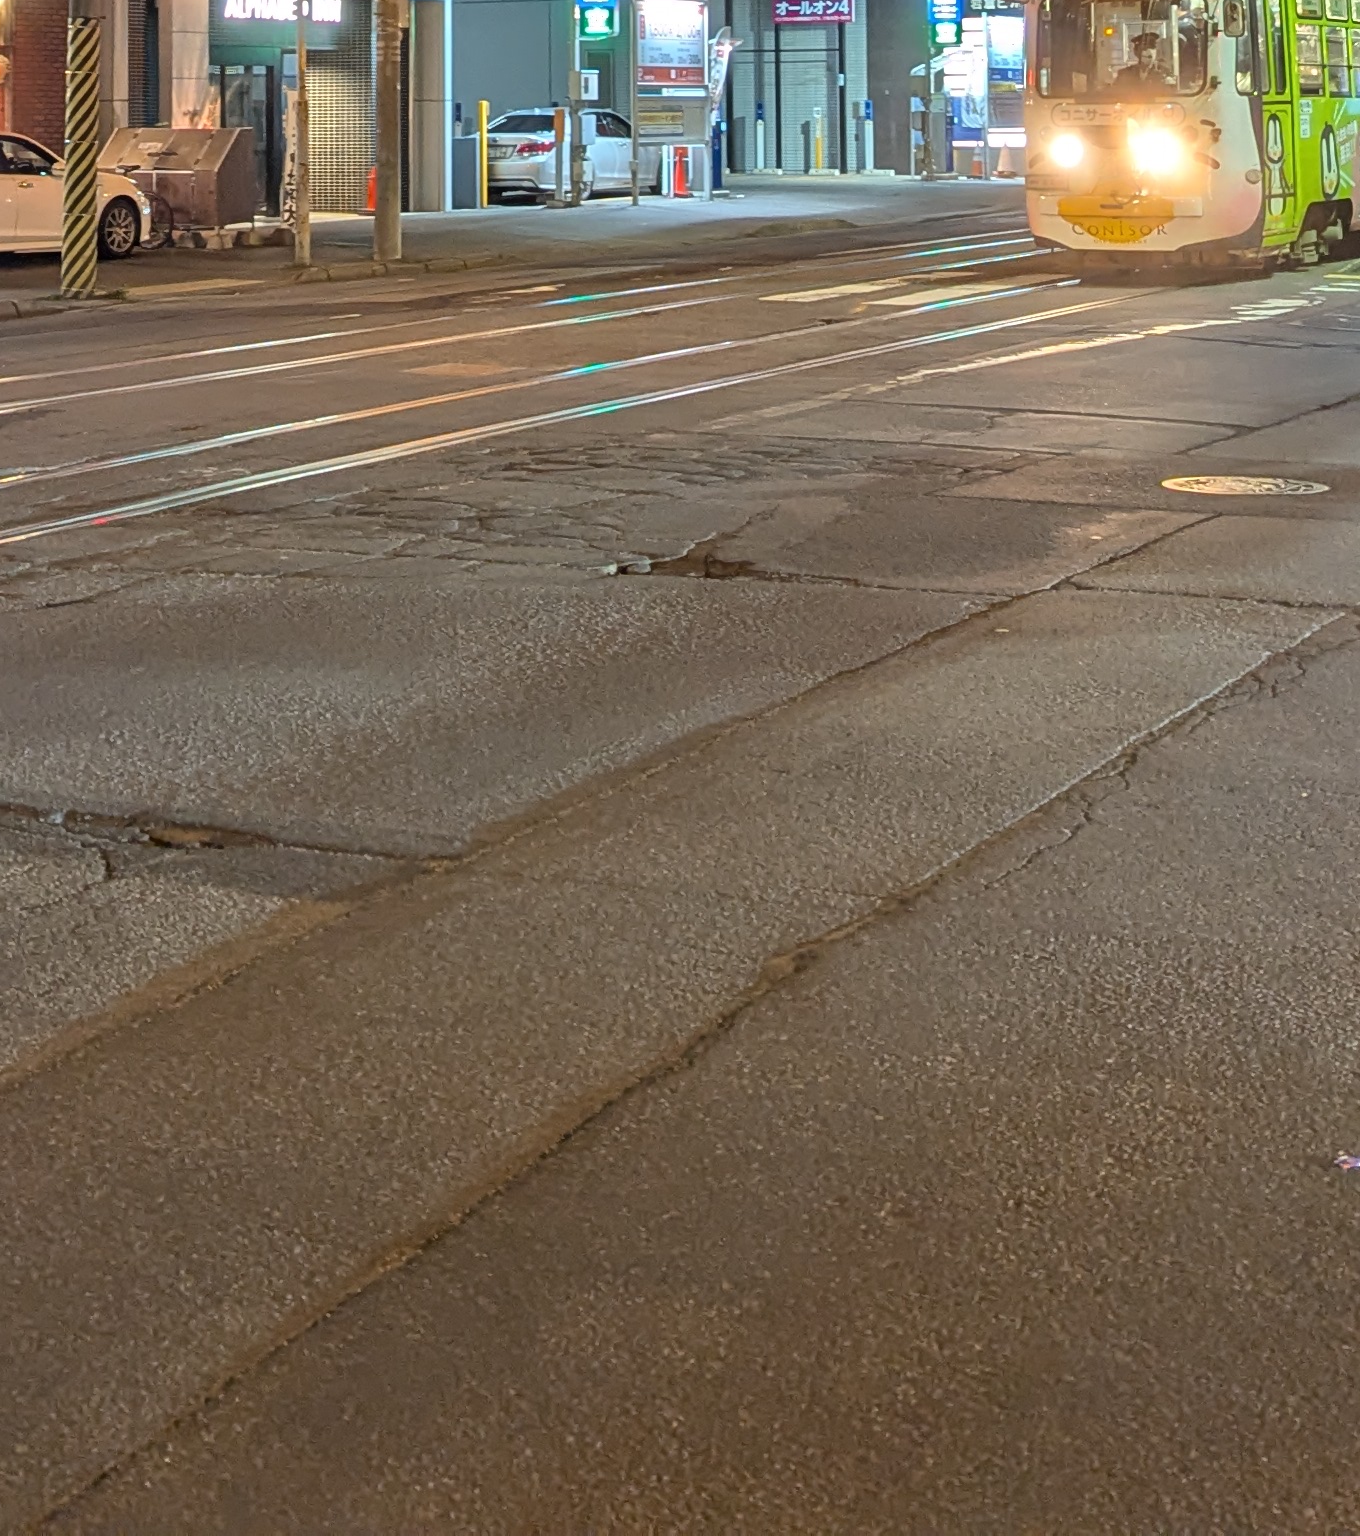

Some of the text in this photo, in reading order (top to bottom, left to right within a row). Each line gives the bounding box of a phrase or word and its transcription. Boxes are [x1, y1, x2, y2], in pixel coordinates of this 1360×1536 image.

[775, 0, 850, 15] オールオン4
[1072, 221, 1168, 237] CONISOR
